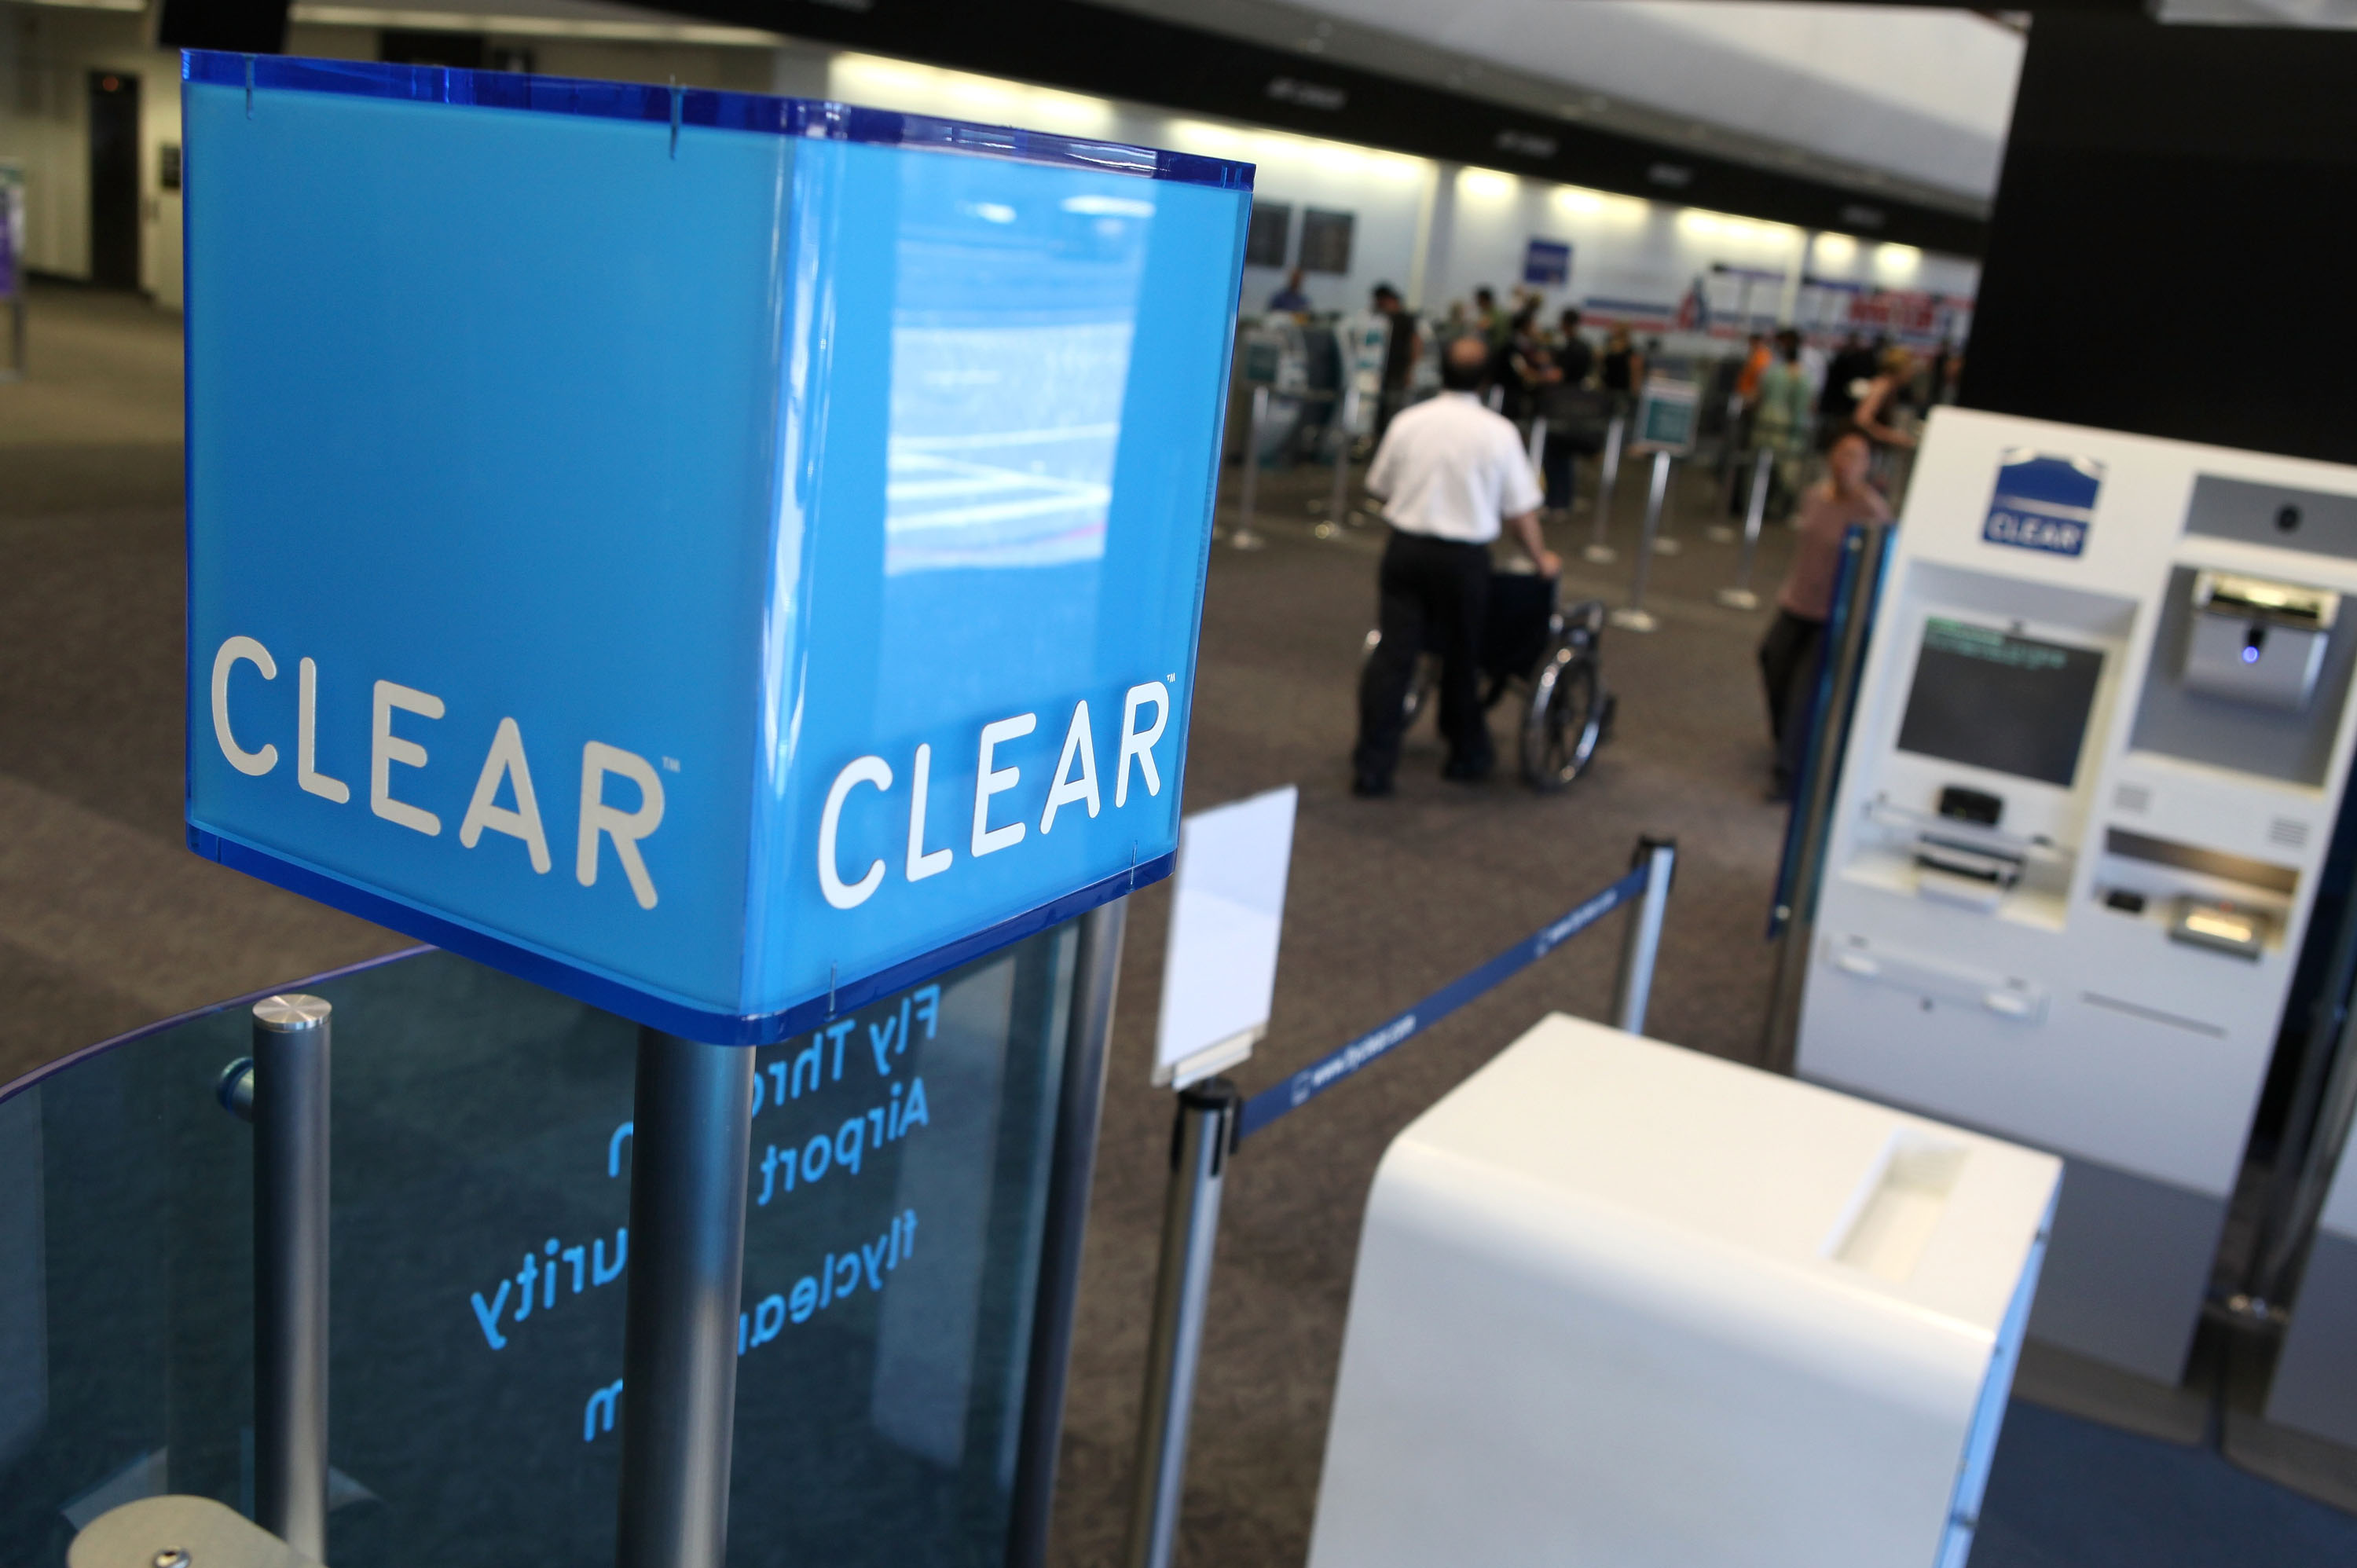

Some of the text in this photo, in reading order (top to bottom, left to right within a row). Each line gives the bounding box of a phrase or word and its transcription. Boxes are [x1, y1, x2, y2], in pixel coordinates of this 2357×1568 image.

[1986, 512, 2082, 552] CLEAR
[211, 635, 665, 910] CLEAR
[817, 680, 1170, 910] CLEAR
